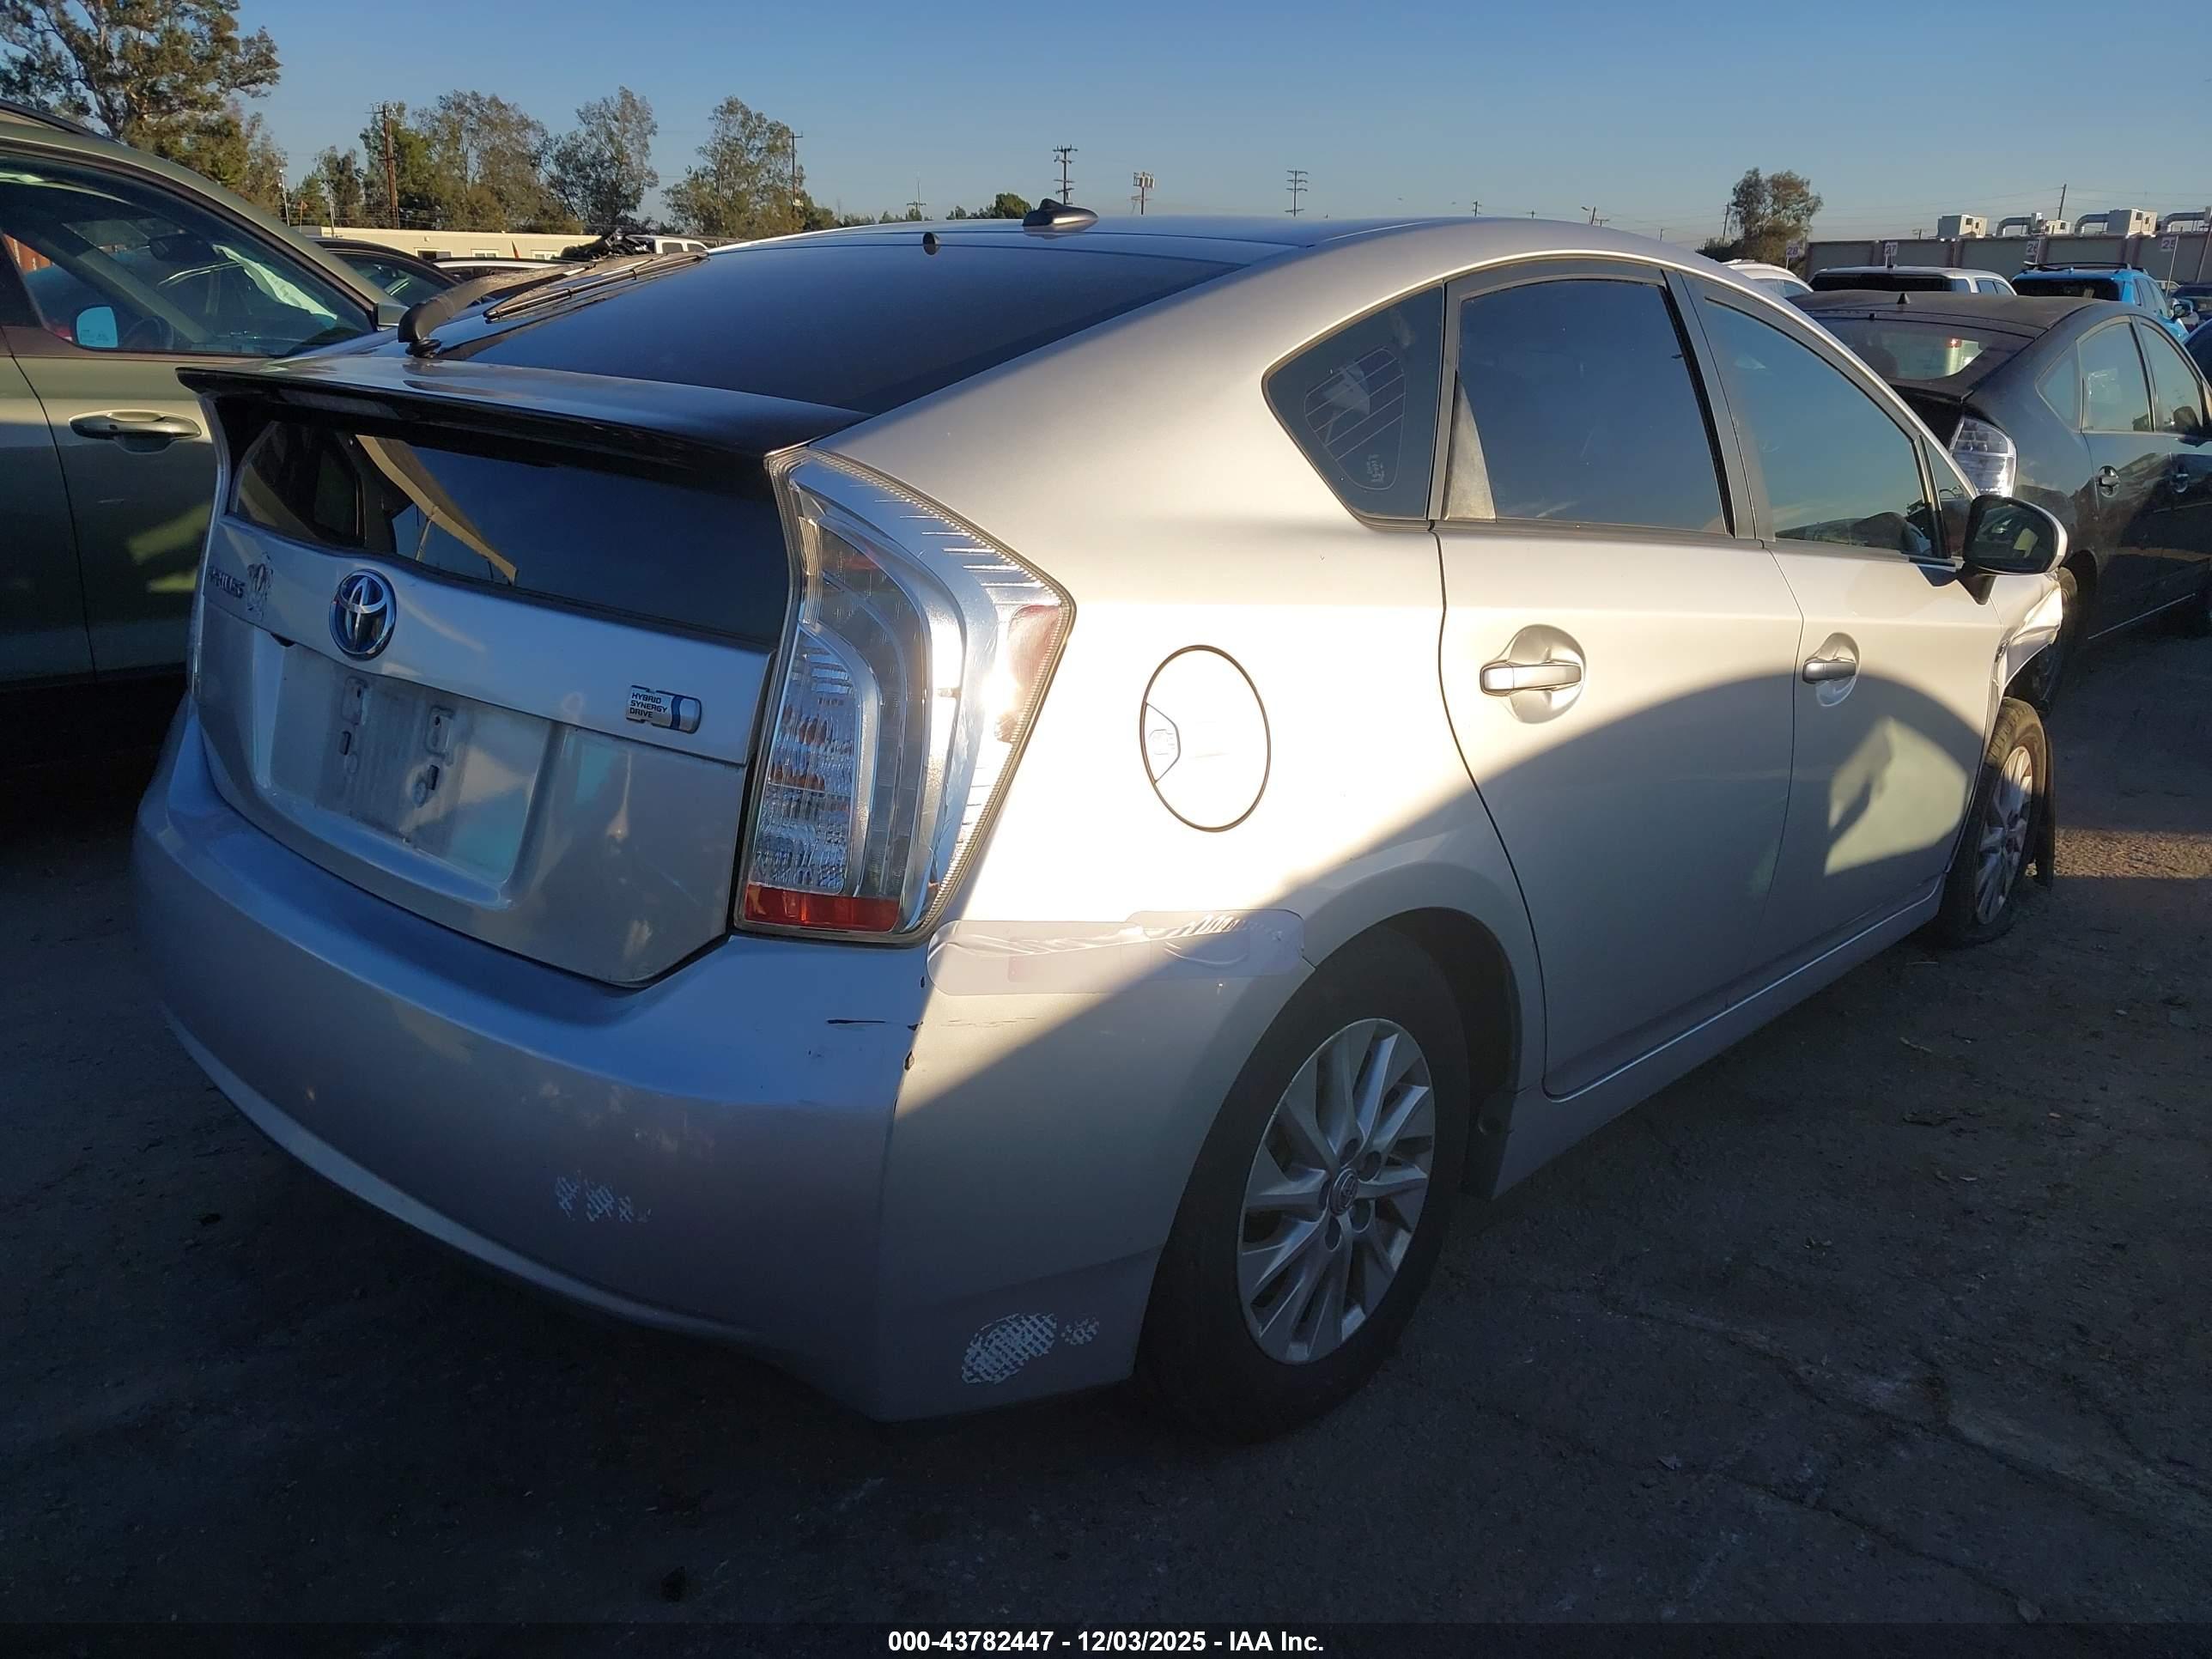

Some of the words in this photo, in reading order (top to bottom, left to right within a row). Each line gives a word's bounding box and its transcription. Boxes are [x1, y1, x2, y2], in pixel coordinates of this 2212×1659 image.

[1786, 246, 1799, 256] 28
[1886, 244, 1897, 254] 27
[631, 691, 662, 704] HYBRID
[629, 699, 668, 714] SYNERGY
[629, 707, 653, 719] DRIVE
